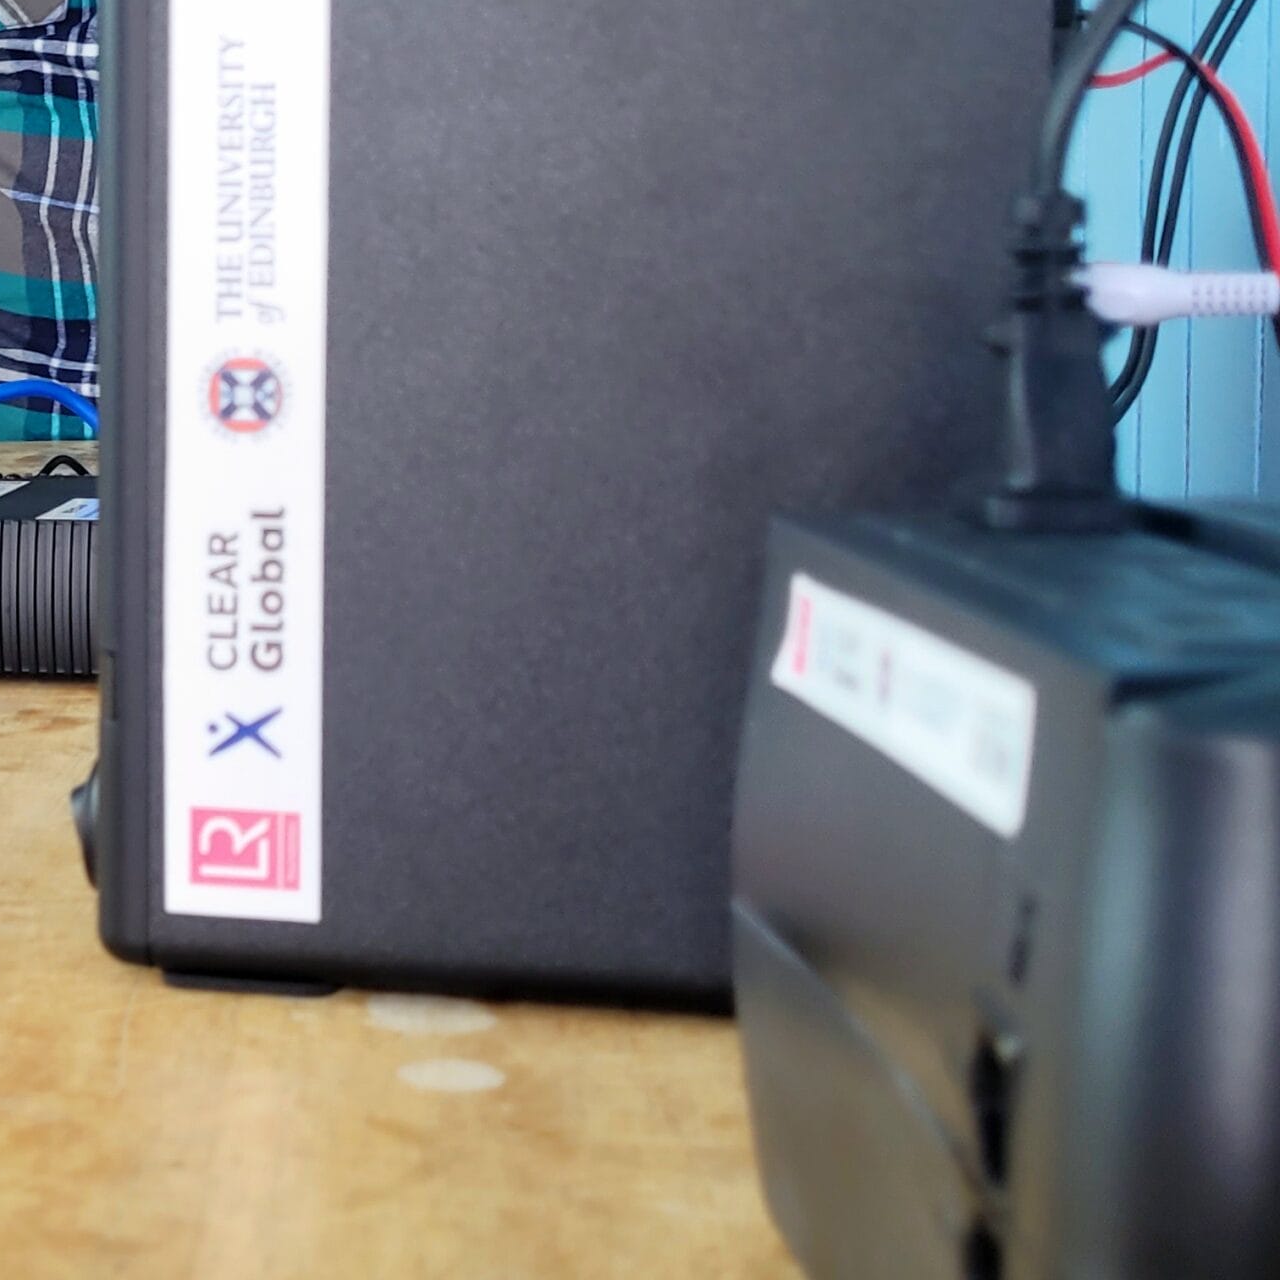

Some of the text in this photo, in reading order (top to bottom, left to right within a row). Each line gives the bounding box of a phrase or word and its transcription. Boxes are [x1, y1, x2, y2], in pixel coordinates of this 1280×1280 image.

[216, 34, 245, 324] THE UNIVERSITY
[248, 82, 276, 288] EDINBURGH
[206, 531, 240, 673] CLEAR
[248, 505, 287, 674] Global
